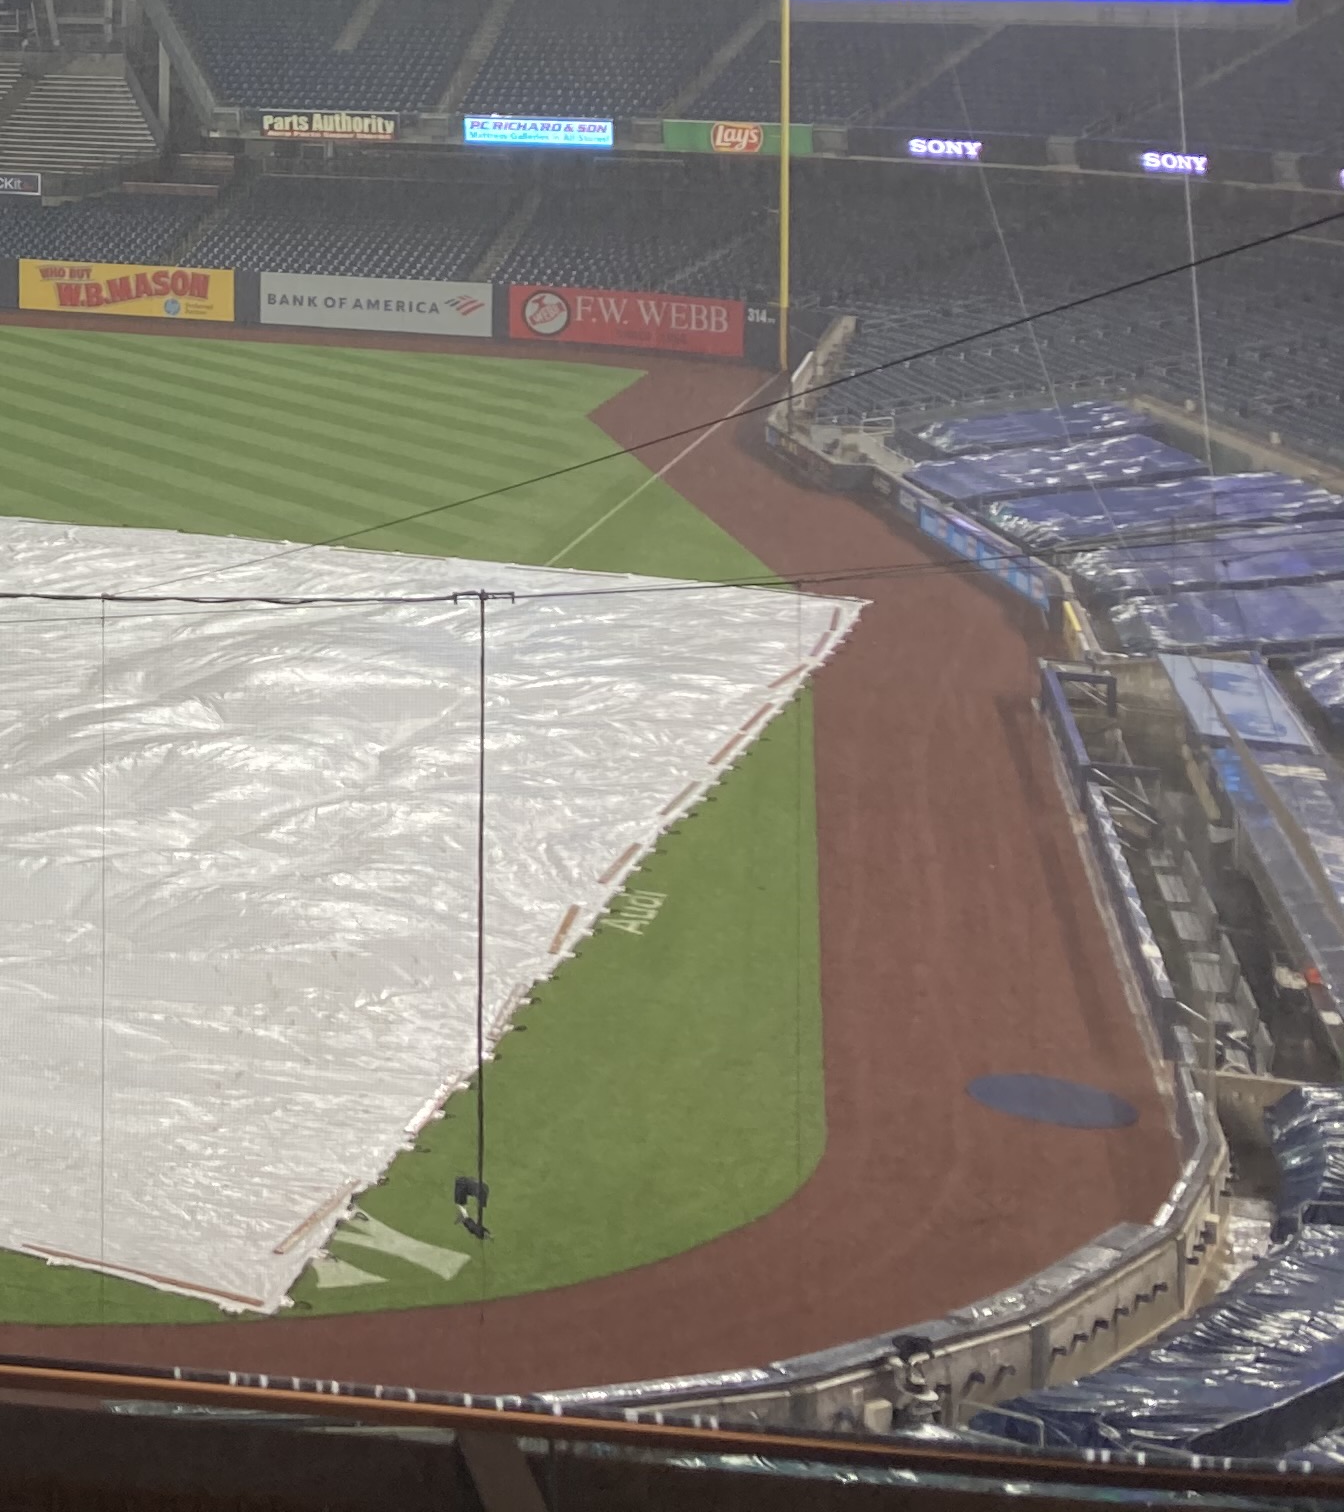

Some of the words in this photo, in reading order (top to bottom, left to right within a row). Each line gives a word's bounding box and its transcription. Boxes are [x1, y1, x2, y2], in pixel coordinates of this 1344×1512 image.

[263, 115, 309, 130] Parts
[312, 113, 395, 133] Authority
[493, 121, 561, 131] RICHARD
[577, 124, 607, 133] SON
[910, 139, 982, 157] SONY
[1144, 153, 1207, 172] SONY
[40, 267, 66, 279] WHO
[69, 268, 92, 279] BUT
[107, 270, 210, 303] MASON
[268, 293, 317, 307] BANK
[324, 296, 347, 308] OF
[352, 299, 440, 314] AMERICA
[575, 296, 629, 325] F.W.
[636, 299, 729, 333] WEBB
[748, 308, 767, 324] 314
